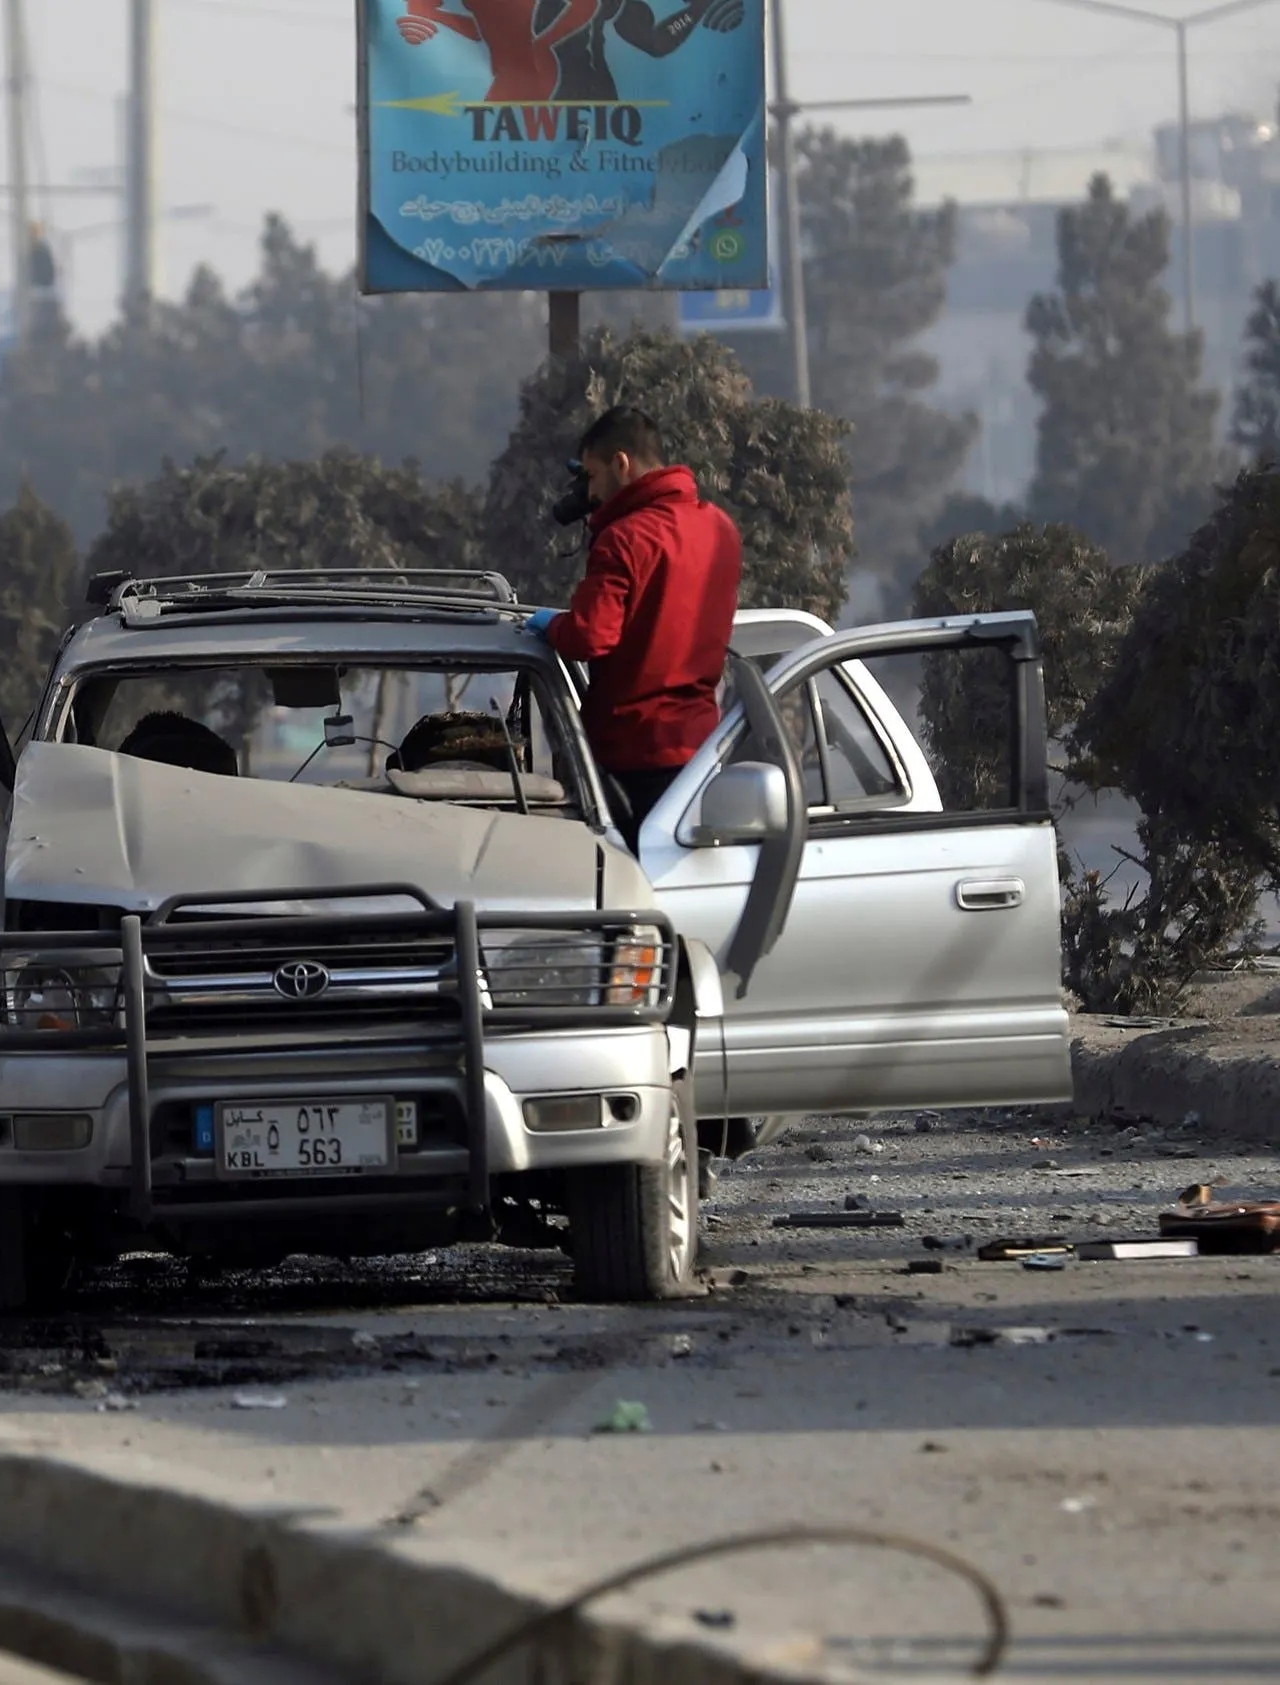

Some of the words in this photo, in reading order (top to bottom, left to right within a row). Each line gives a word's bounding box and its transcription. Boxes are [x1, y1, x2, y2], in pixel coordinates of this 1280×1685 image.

[668, 13, 692, 36] 2014
[464, 105, 643, 146] TAWFIQ
[391, 150, 562, 180] Bodybuilding
[569, 149, 589, 173] &
[227, 1152, 264, 1168] KBL
[298, 1138, 342, 1165] 563
